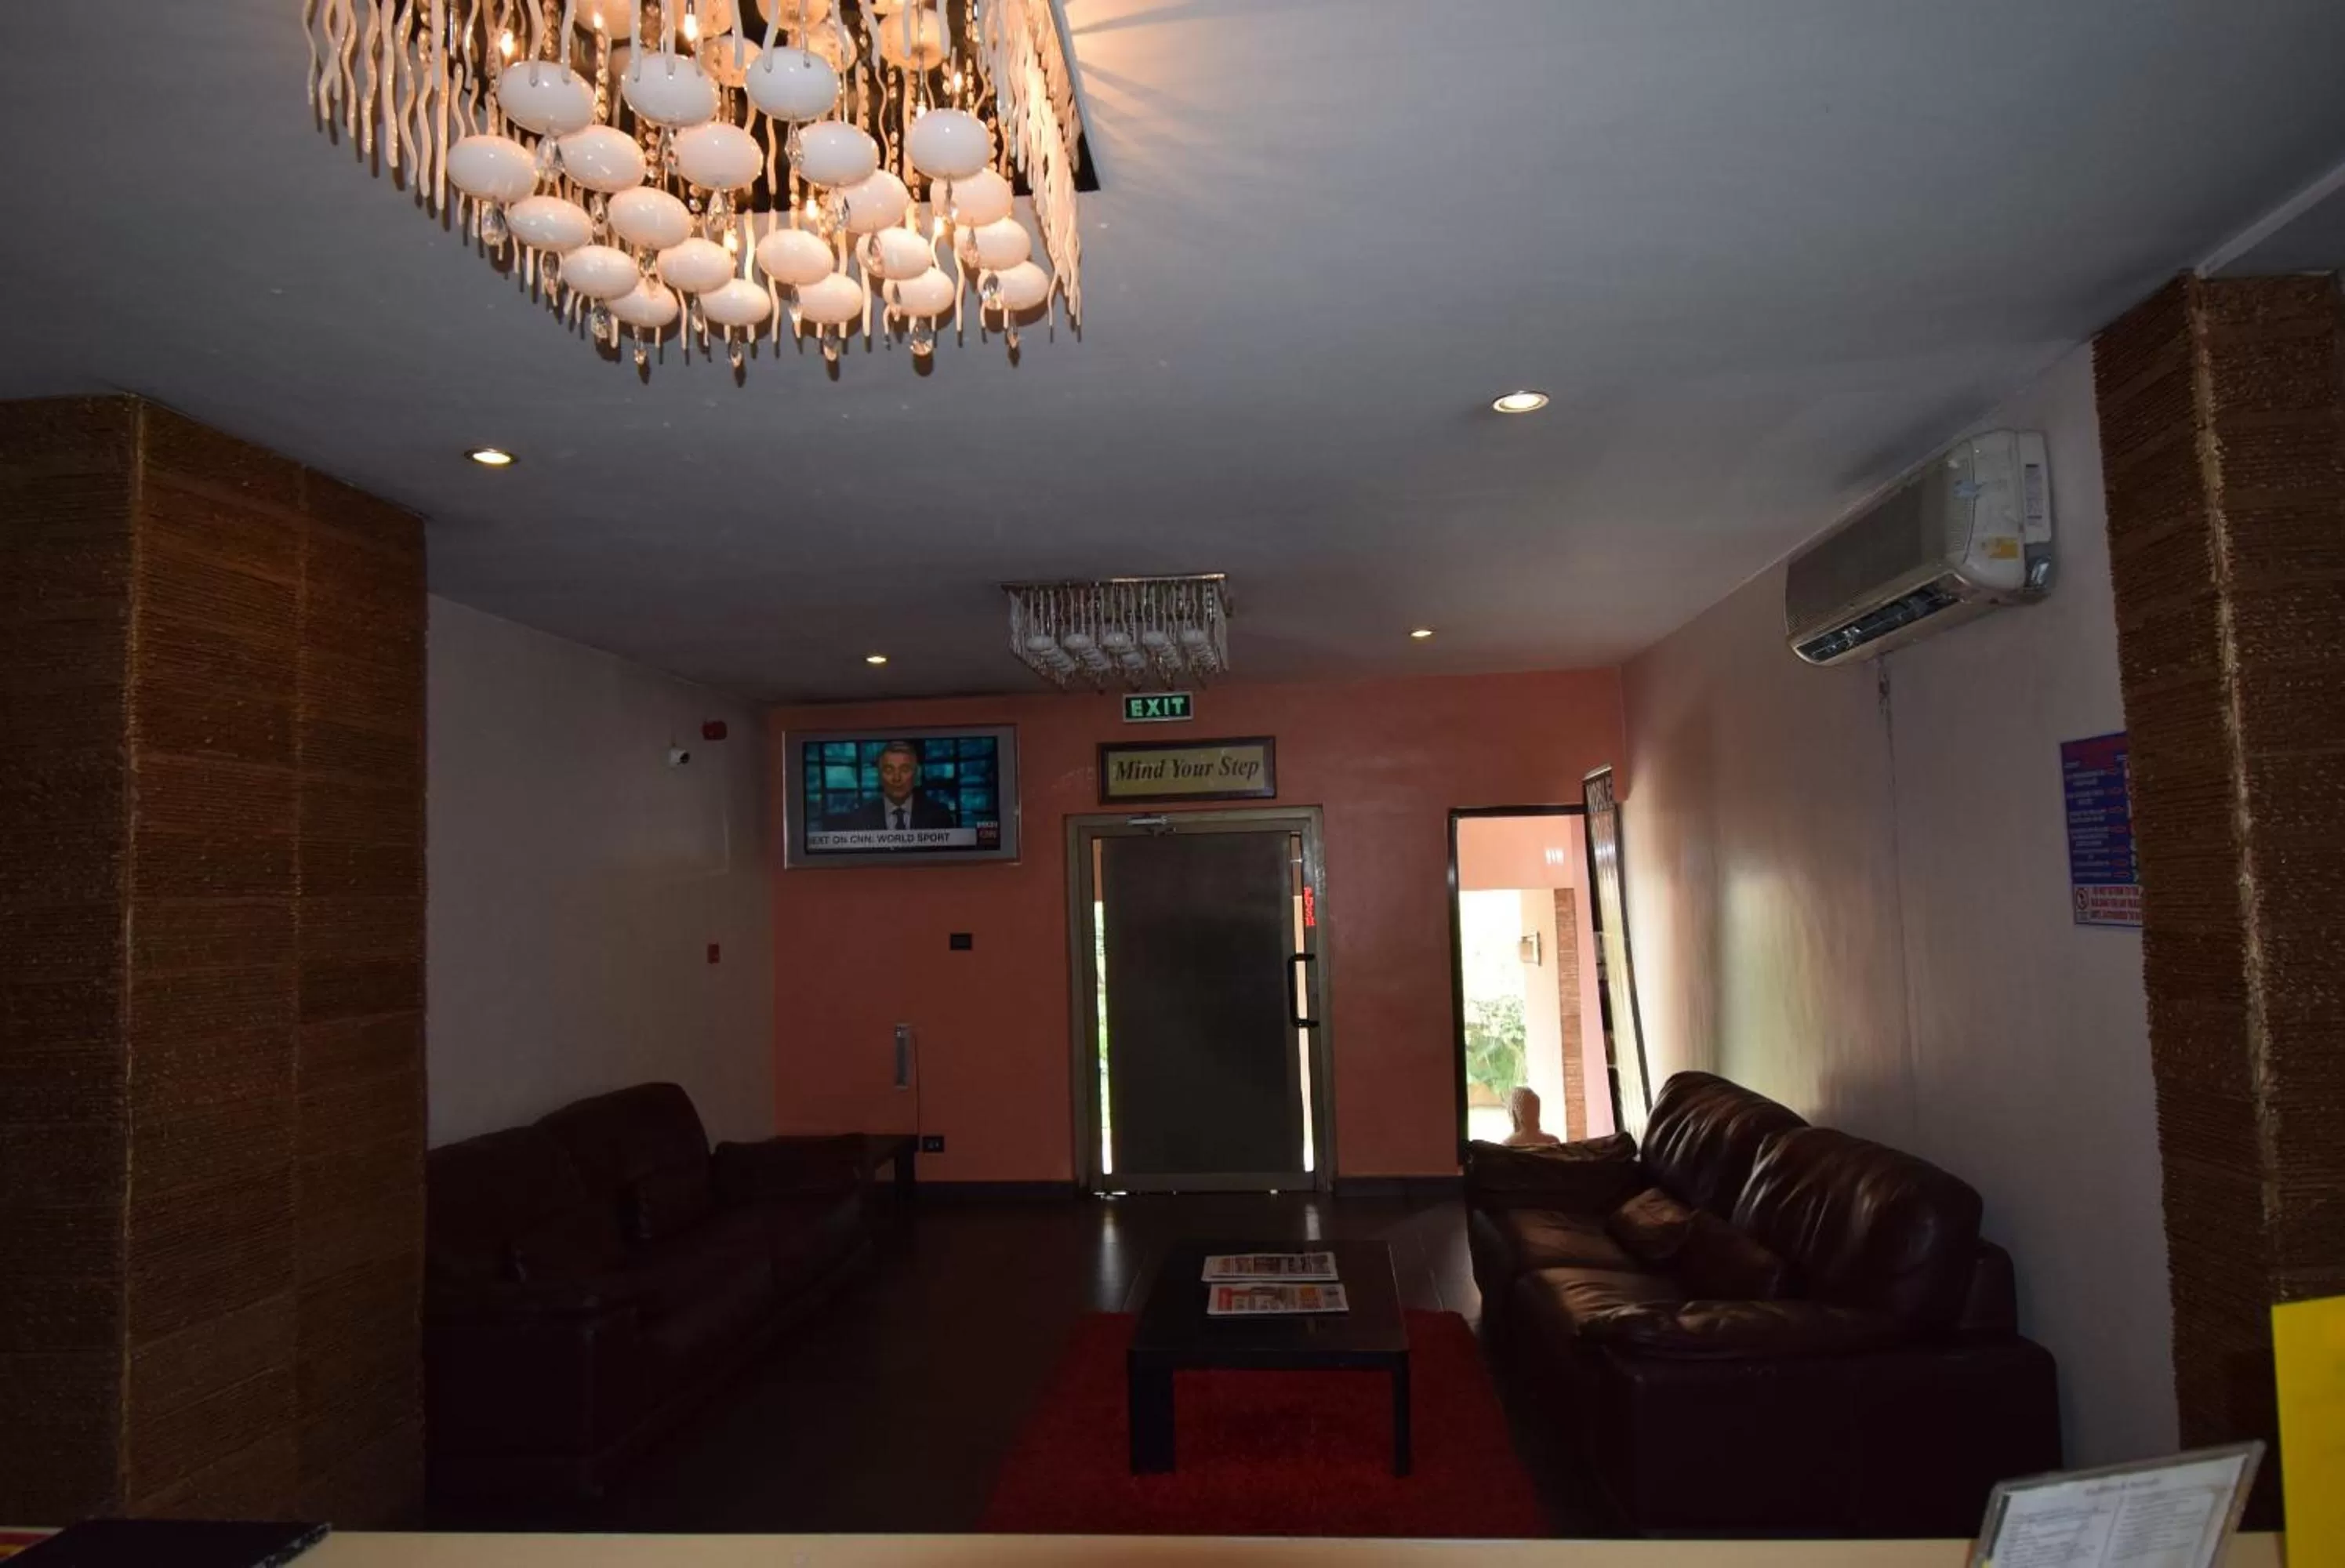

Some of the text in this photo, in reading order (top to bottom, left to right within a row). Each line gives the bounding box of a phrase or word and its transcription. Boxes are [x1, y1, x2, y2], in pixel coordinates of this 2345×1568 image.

[1130, 696, 1185, 717] EXIT
[1116, 756, 1260, 781] Mind Your Step
[877, 833, 915, 844] WORLD
[917, 832, 951, 844] SPORT
